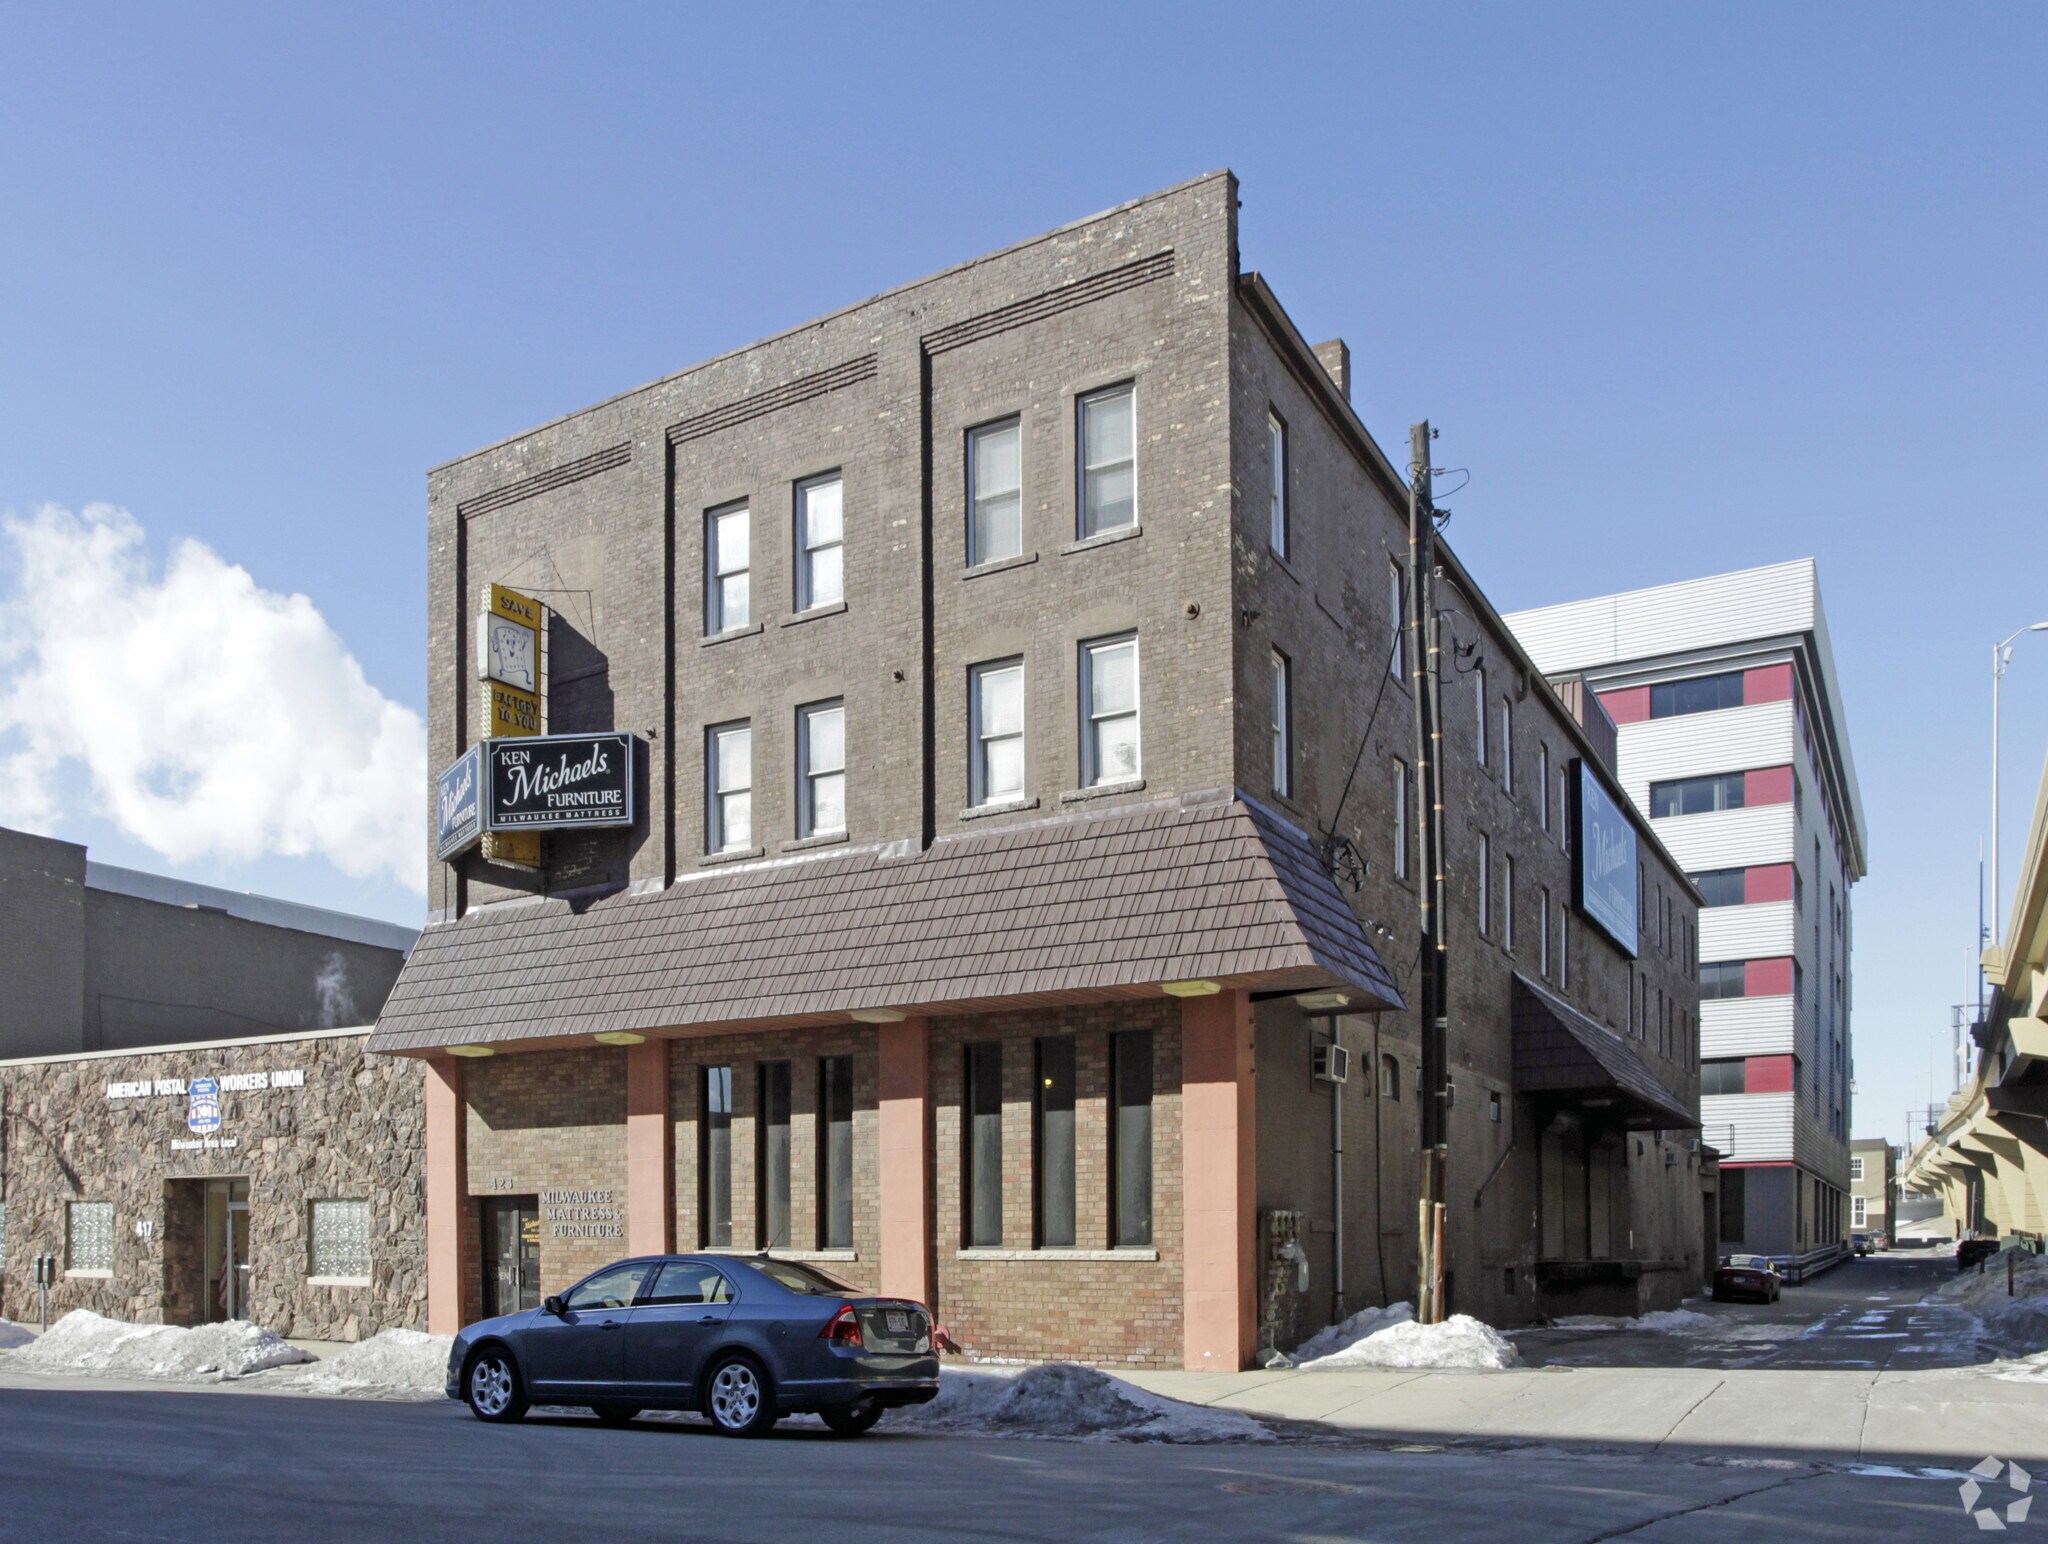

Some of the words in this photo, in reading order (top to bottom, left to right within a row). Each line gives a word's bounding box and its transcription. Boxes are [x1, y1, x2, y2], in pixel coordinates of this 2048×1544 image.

[501, 596, 534, 621] SAVE
[493, 689, 538, 715] FACTORY
[498, 706, 512, 721] TO
[515, 713, 537, 731] YOU
[501, 751, 530, 765] KEN
[502, 742, 608, 806] Michaels
[547, 790, 622, 807] FURNITURE
[451, 802, 476, 830] FURNITURE
[500, 813, 559, 822] MILWAUKEE
[566, 810, 620, 818] MATTRESS
[1592, 821, 1627, 882] Michaels
[106, 1080, 152, 1099] AMERICAN
[154, 1079, 187, 1095] POSTAL
[220, 1071, 268, 1091] WORKERS
[271, 1069, 304, 1088] UNION
[171, 1138, 203, 1150] Milwaukee
[204, 1136, 220, 1148] Area
[221, 1135, 237, 1148] Local
[490, 1177, 514, 1190] 423
[542, 1190, 613, 1204] MILWAUKEE
[547, 1207, 613, 1220] MATTRESS
[614, 1209, 623, 1220] &
[136, 1221, 152, 1237] 417
[553, 1224, 623, 1237] FURNITURE
